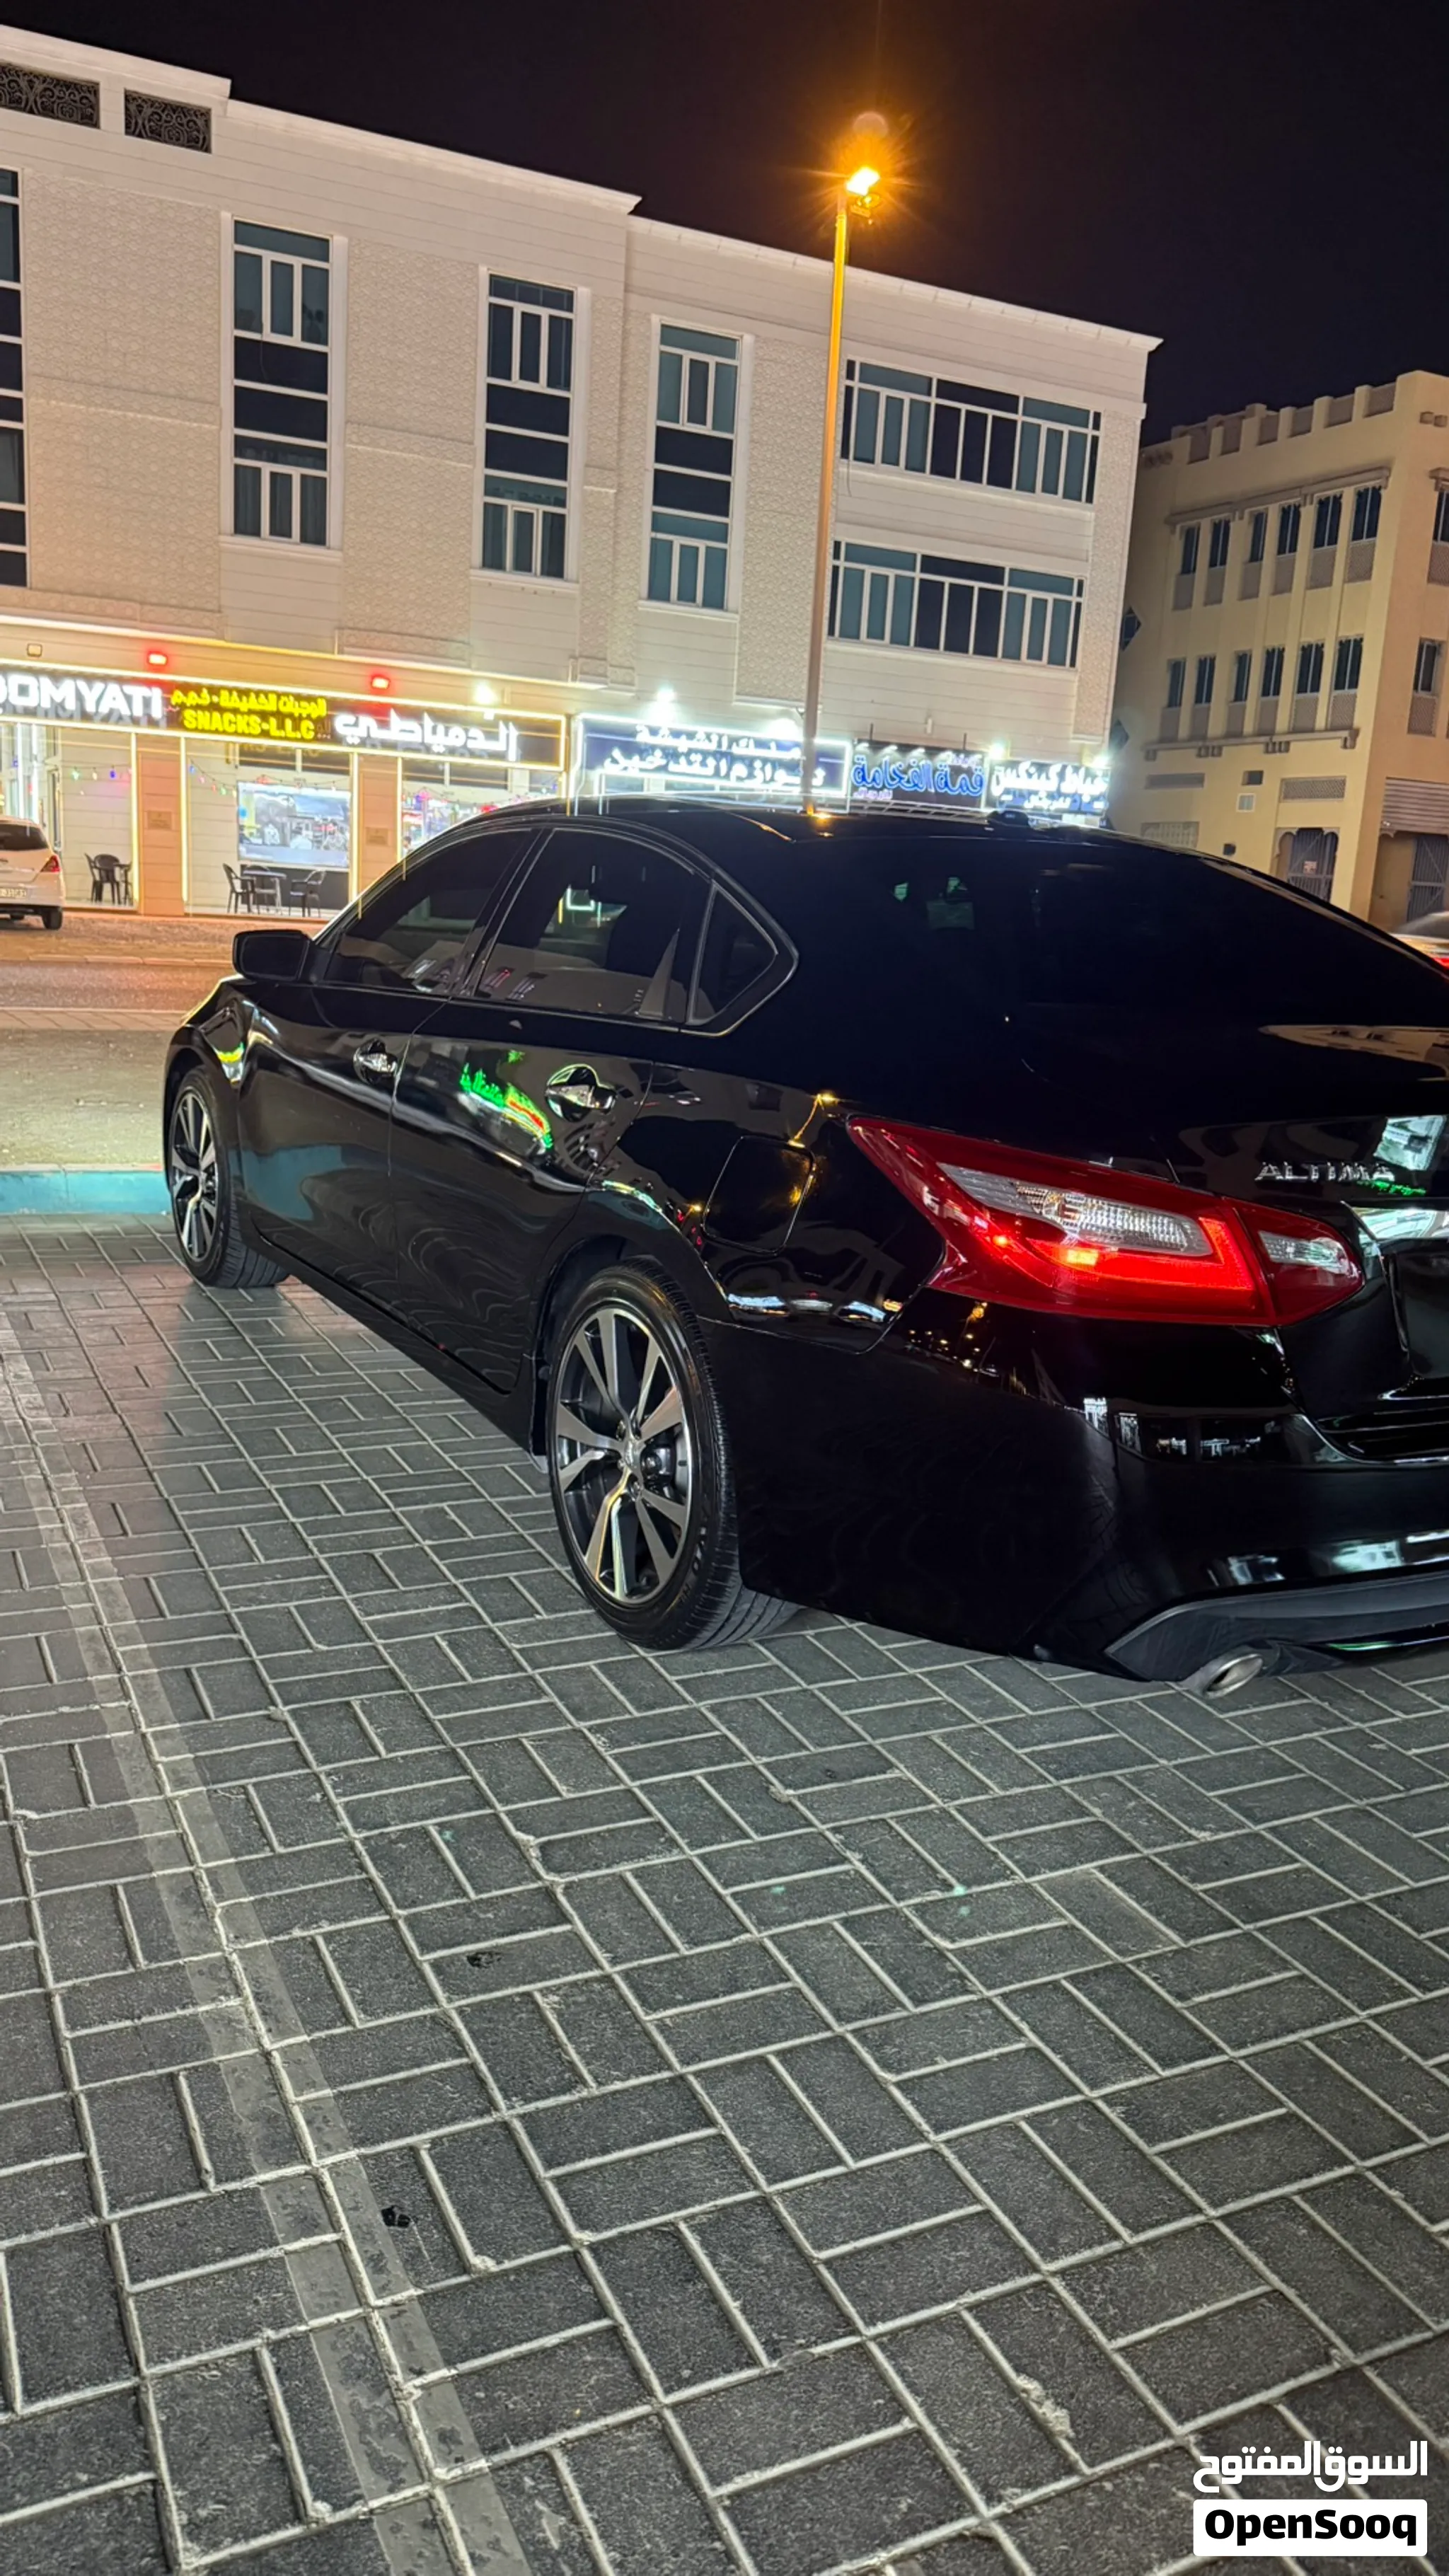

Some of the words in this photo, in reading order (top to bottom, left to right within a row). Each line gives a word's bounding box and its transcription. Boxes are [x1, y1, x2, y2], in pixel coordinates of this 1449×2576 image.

[0, 674, 163, 719] OMYATI
[334, 707, 519, 762] الدمياطي
[635, 724, 727, 753] الشيشة
[604, 746, 727, 777] التدخين
[851, 754, 935, 793] الفخامة
[935, 763, 986, 797] قمة
[1254, 1162, 1395, 1182] ALTIMA
